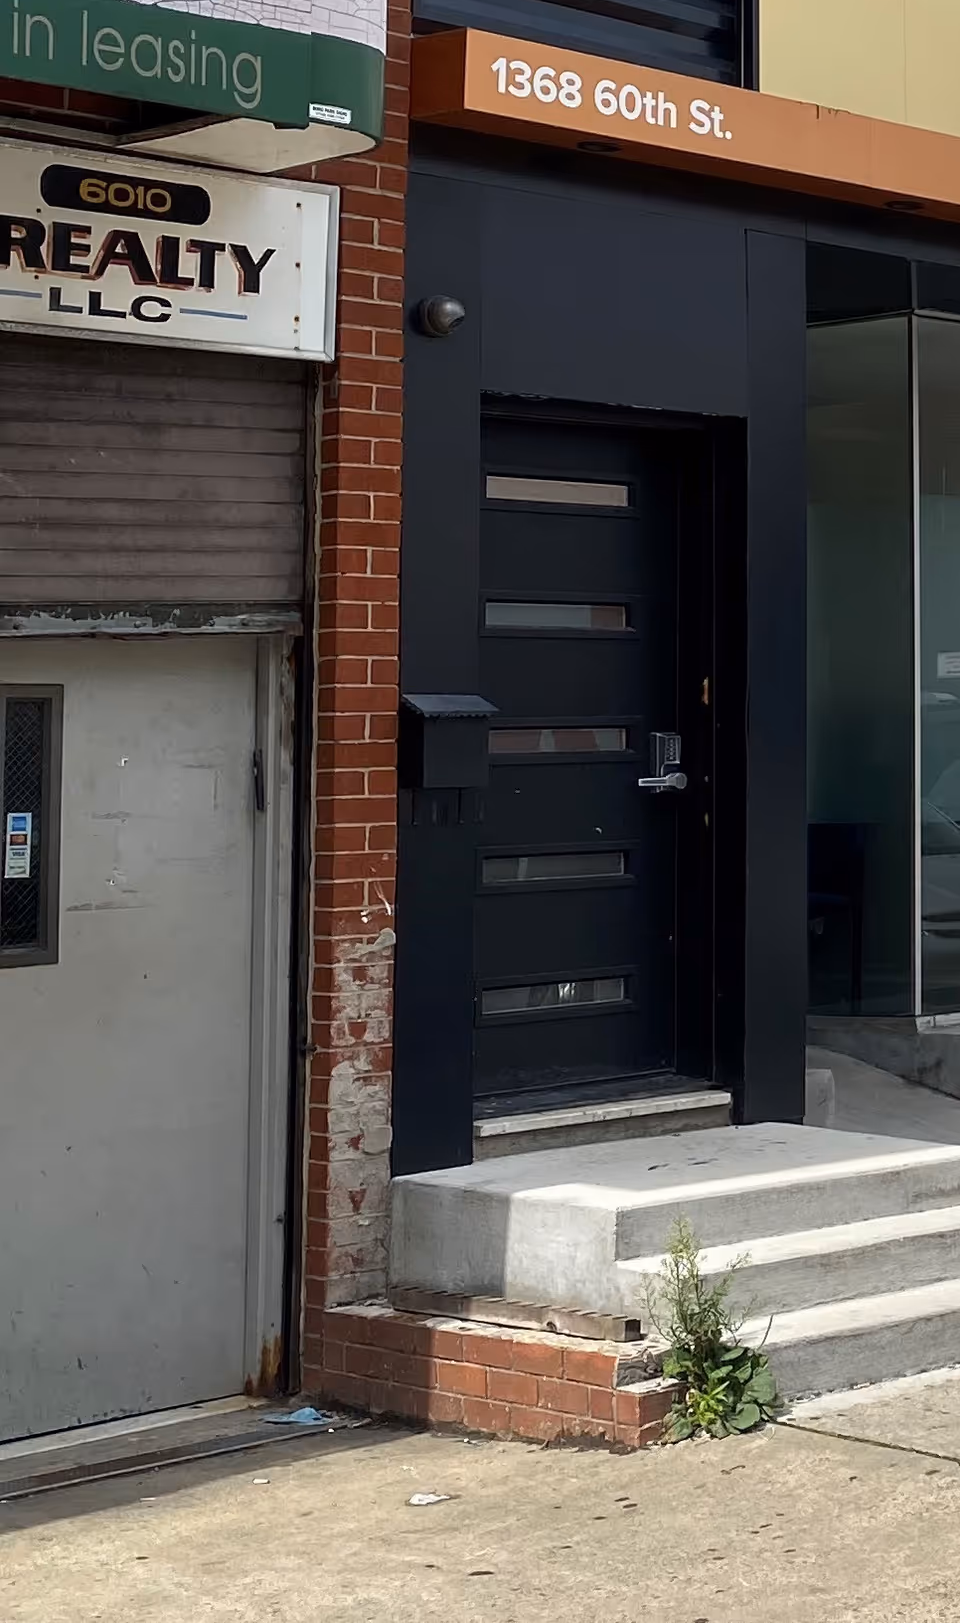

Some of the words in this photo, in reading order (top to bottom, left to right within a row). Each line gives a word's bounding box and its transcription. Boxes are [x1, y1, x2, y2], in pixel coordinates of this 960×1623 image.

[81, 9, 263, 110] leasing
[490, 56, 582, 108] 1368
[594, 79, 678, 129] 60th
[688, 98, 733, 140] St.
[79, 178, 172, 213] 6010
[0, 214, 277, 296] REALTY
[49, 286, 172, 323] LLC
